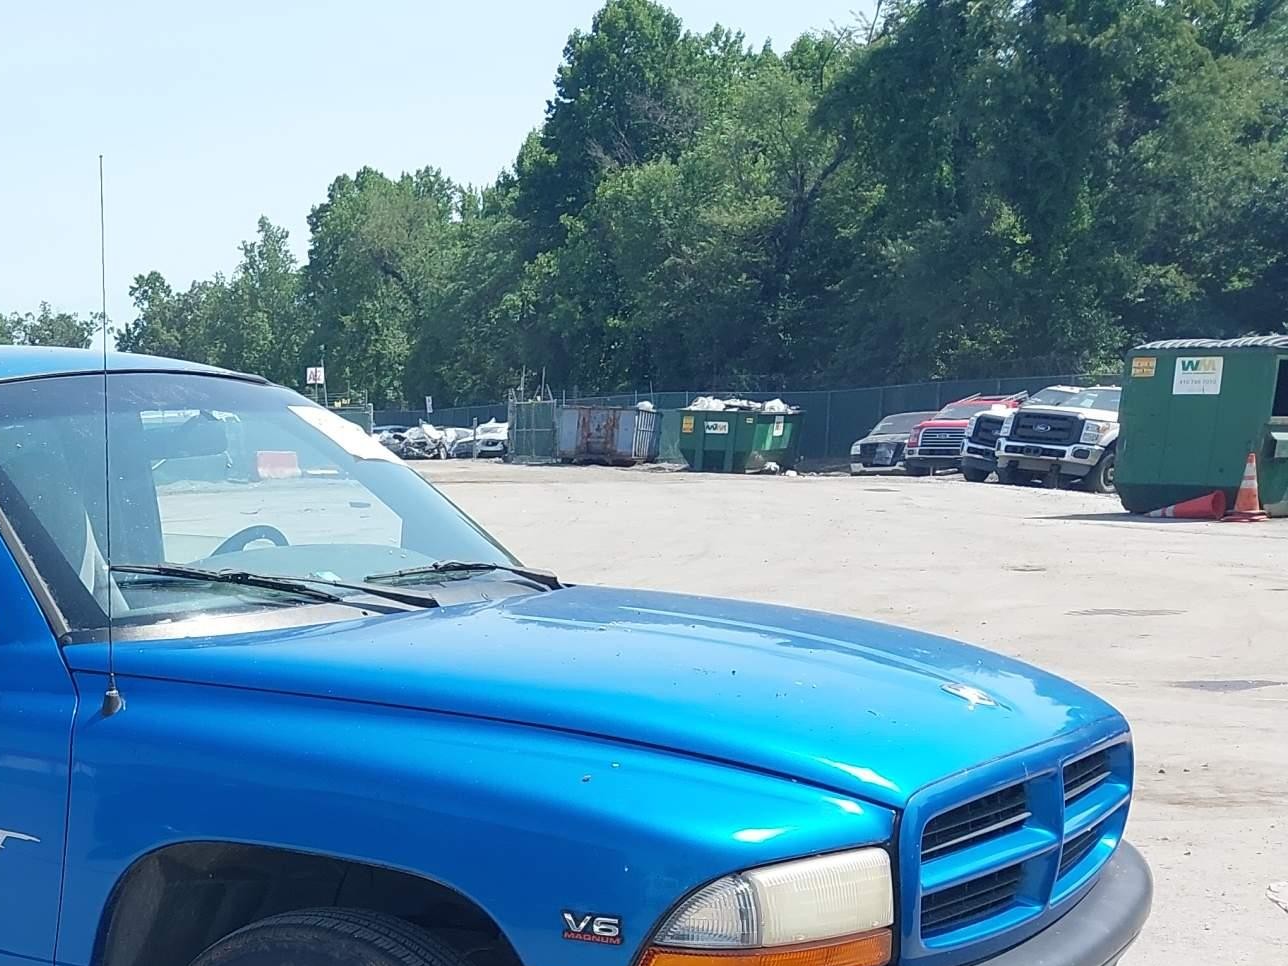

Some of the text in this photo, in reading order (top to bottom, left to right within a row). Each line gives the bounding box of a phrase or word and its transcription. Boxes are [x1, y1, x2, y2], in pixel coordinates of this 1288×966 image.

[1181, 360, 1216, 372] WM
[563, 912, 619, 937] V6
[564, 931, 621, 945] MAGNUM
